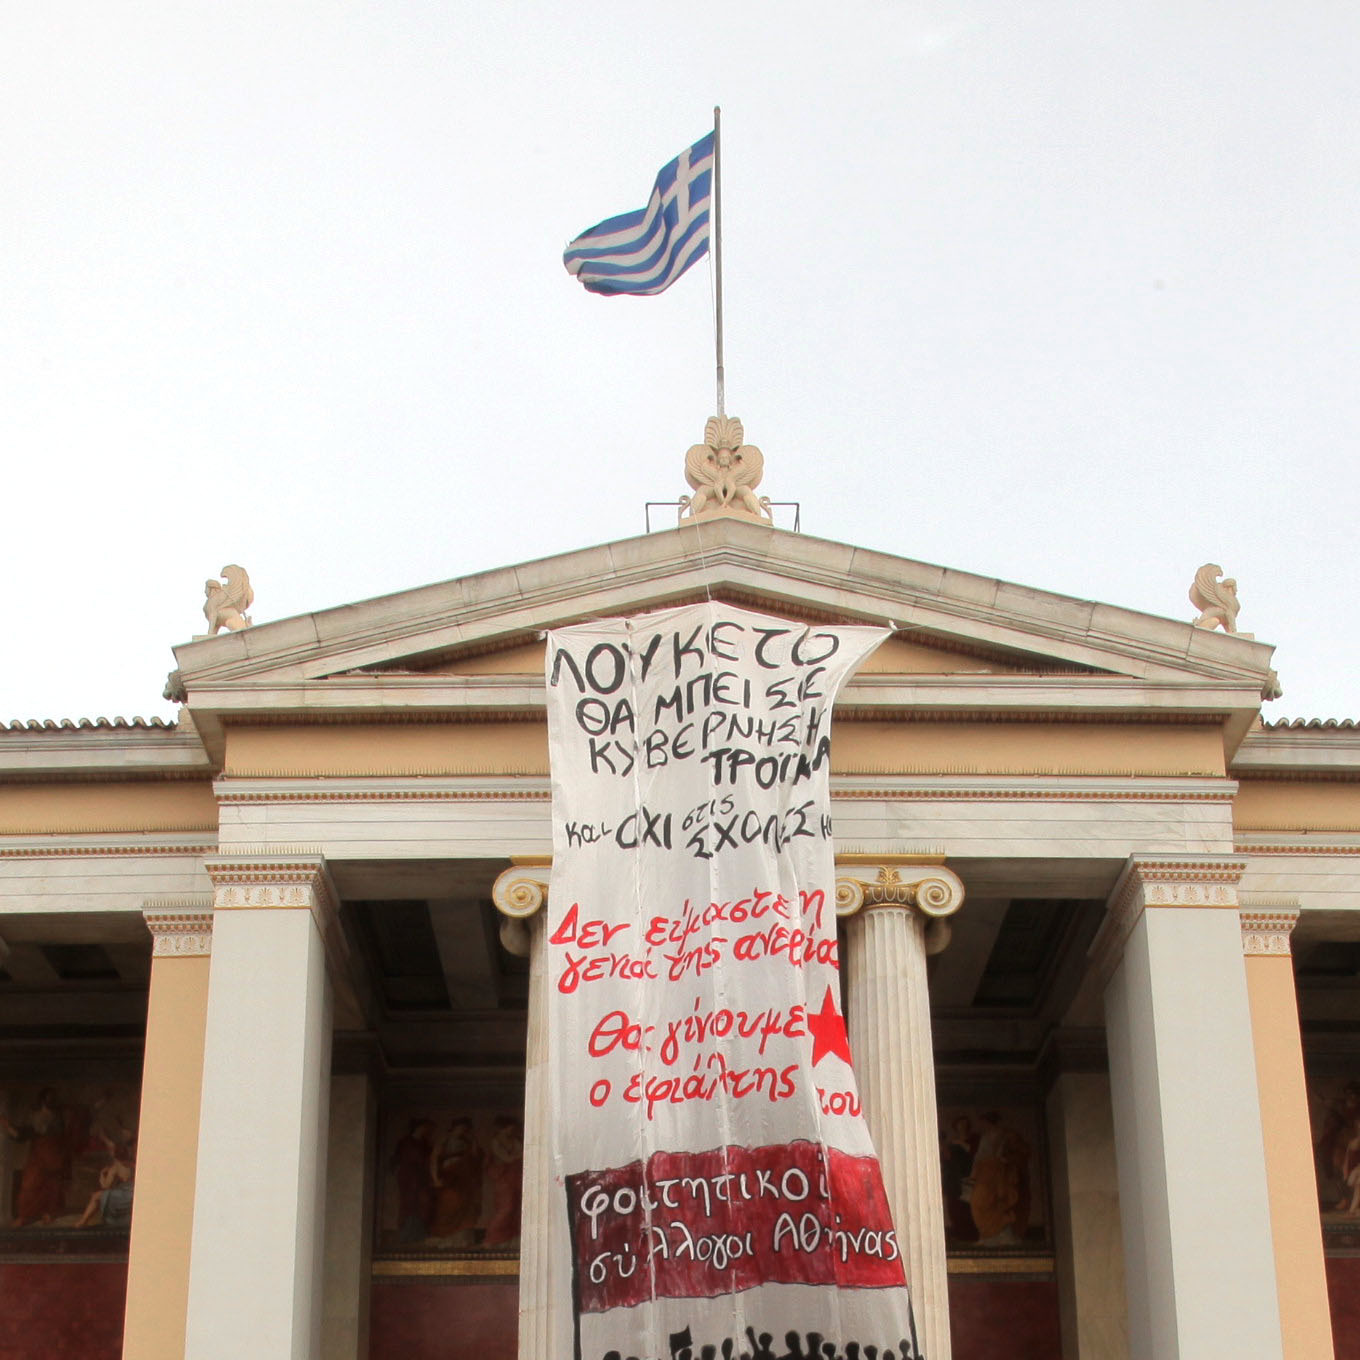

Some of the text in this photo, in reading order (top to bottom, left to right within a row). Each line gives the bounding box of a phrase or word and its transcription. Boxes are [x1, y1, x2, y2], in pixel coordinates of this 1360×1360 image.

[576, 667, 826, 736] ΘΑ ΜΠΕΙ ΣΕ
[589, 706, 826, 777] ΚΥΒΕΡΝΗΣΗ
[615, 806, 672, 849] ΟΧΙ
[549, 903, 631, 948] Δεν
[799, 889, 825, 930] η
[557, 951, 658, 994] γενιά
[669, 938, 728, 981] της
[660, 996, 807, 1066] γίνουμε
[589, 1078, 610, 1107] ο
[623, 1054, 799, 1120] εφιάλτης
[774, 1213, 898, 1262] Αθήνας
